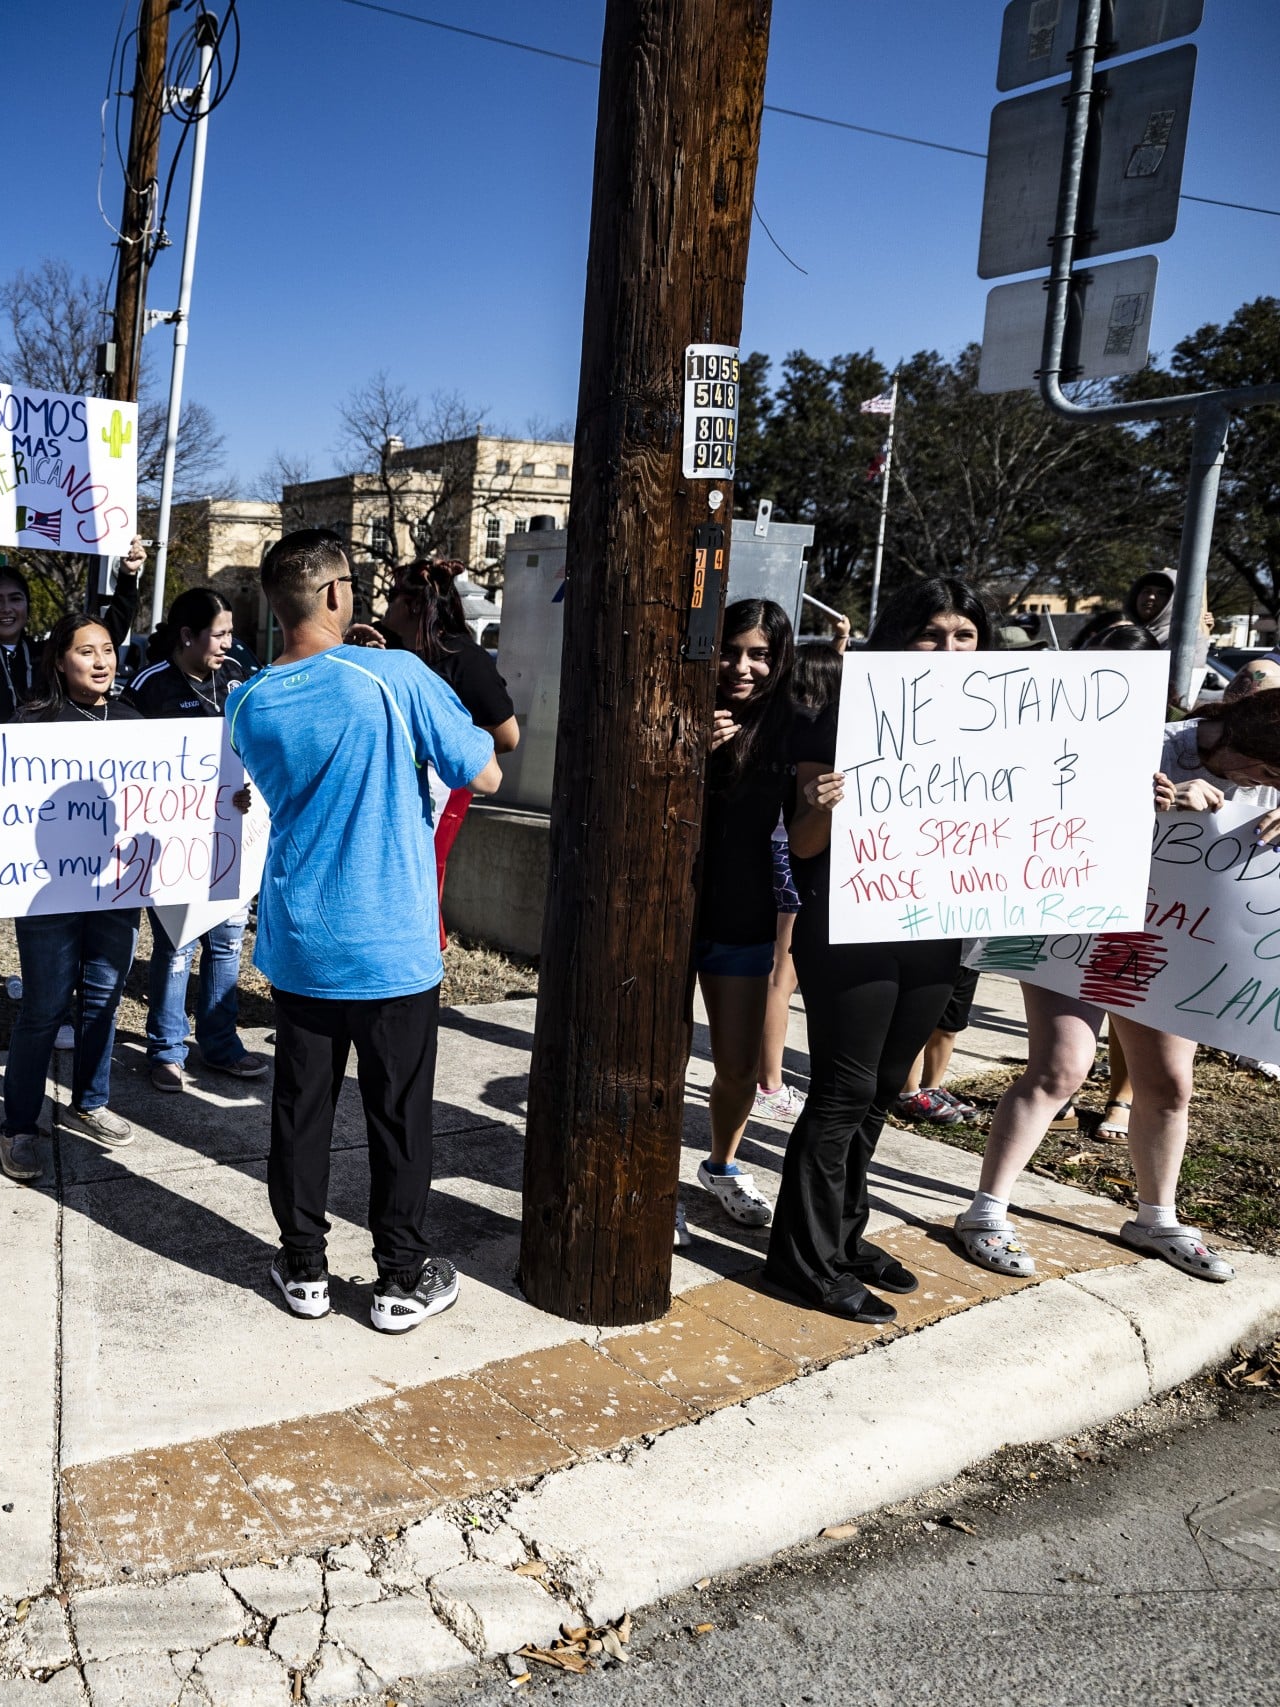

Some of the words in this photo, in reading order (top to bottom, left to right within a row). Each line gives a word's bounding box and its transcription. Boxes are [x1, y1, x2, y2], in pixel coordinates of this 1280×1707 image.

[690, 355, 739, 382] 1955
[695, 383, 734, 407] 548
[12, 434, 61, 458] MAS
[698, 417, 734, 440] 804
[868, 669, 936, 761] WE
[959, 667, 1130, 732] STAND
[1, 733, 219, 800] Immigrants
[1052, 738, 1079, 810] &
[2, 799, 58, 827] are
[67, 799, 108, 836] my
[120, 784, 232, 832] PEOPLE
[849, 821, 902, 864] WE
[916, 816, 1012, 858] SPEAK
[1030, 815, 1095, 852] FOR
[1151, 818, 1280, 882] BOD
[59, 856, 102, 902] my
[109, 831, 237, 903] BLOOD
[1003, 895, 1025, 927] la
